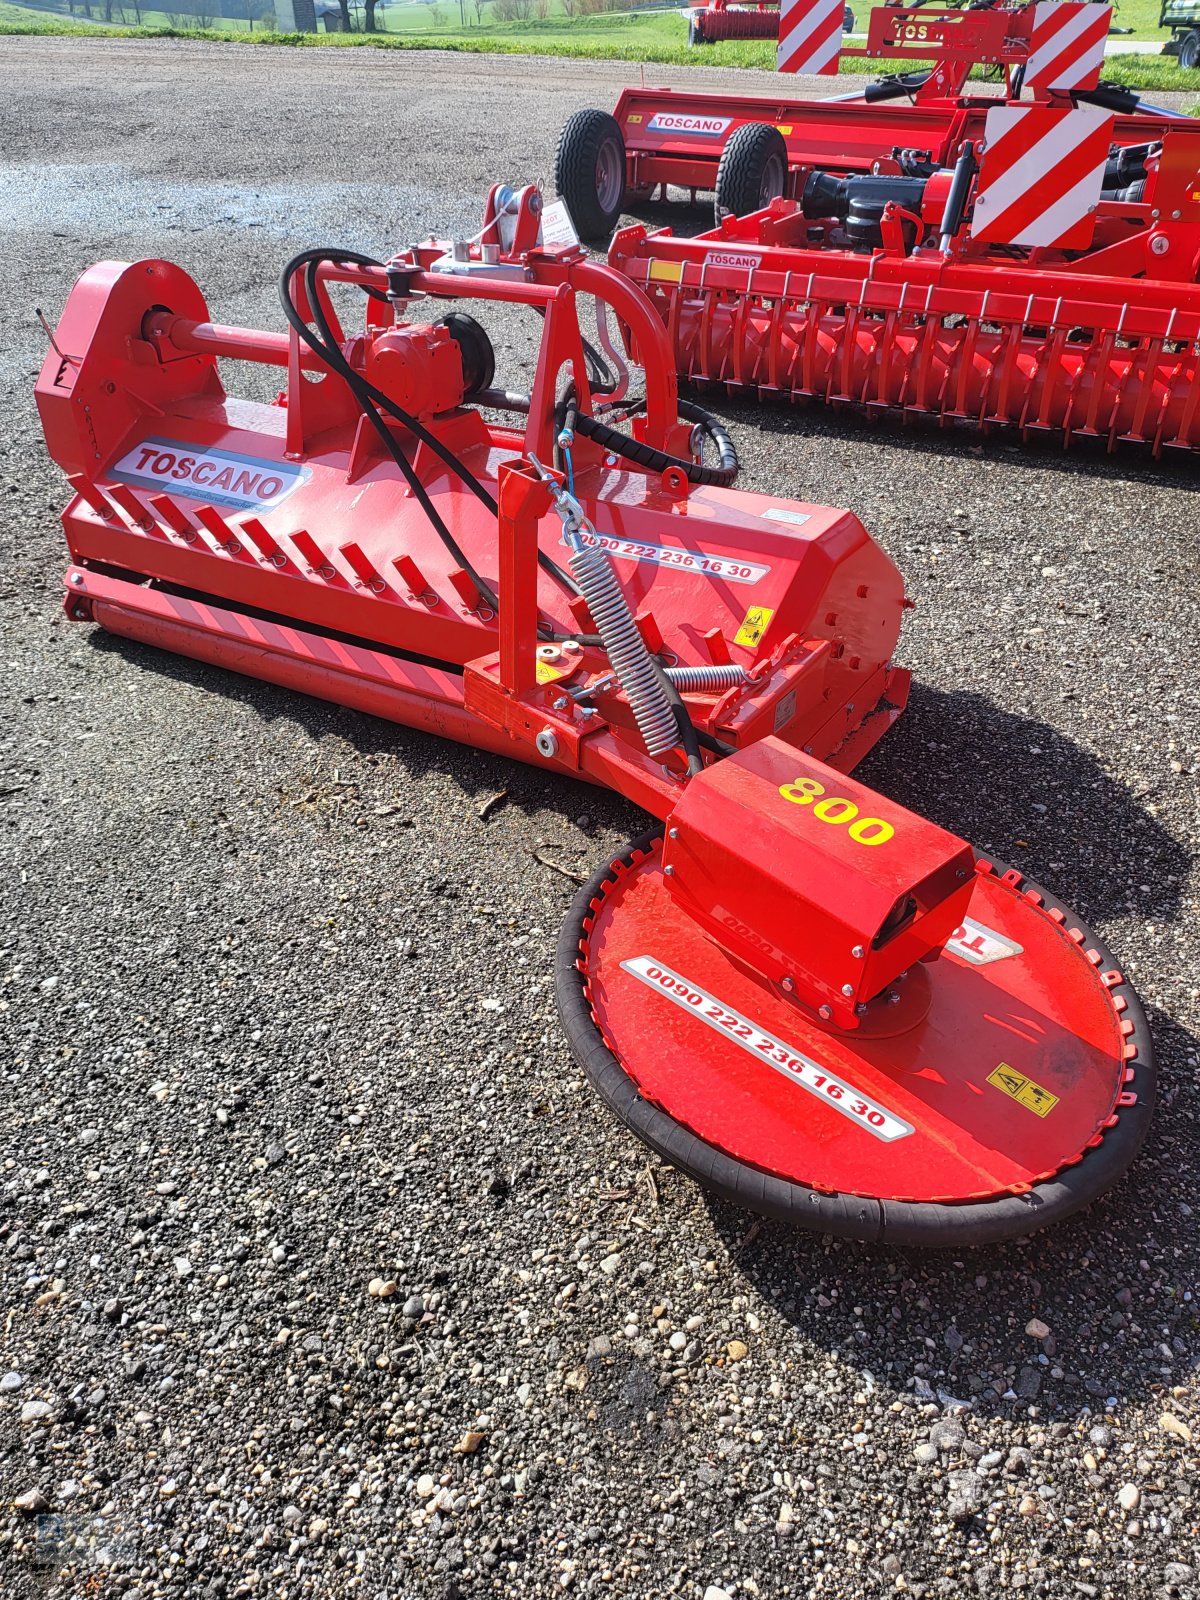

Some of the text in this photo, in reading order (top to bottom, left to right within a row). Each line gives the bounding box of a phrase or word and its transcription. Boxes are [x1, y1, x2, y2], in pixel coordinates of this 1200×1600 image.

[657, 117, 723, 131] TOSCANO
[709, 254, 757, 267] TOSCANO
[136, 447, 284, 500] TOSCANO
[580, 534, 752, 578] 0090 222 236 16 30
[778, 777, 895, 846] 800
[645, 966, 886, 1128] 0090 222 236 16 30
